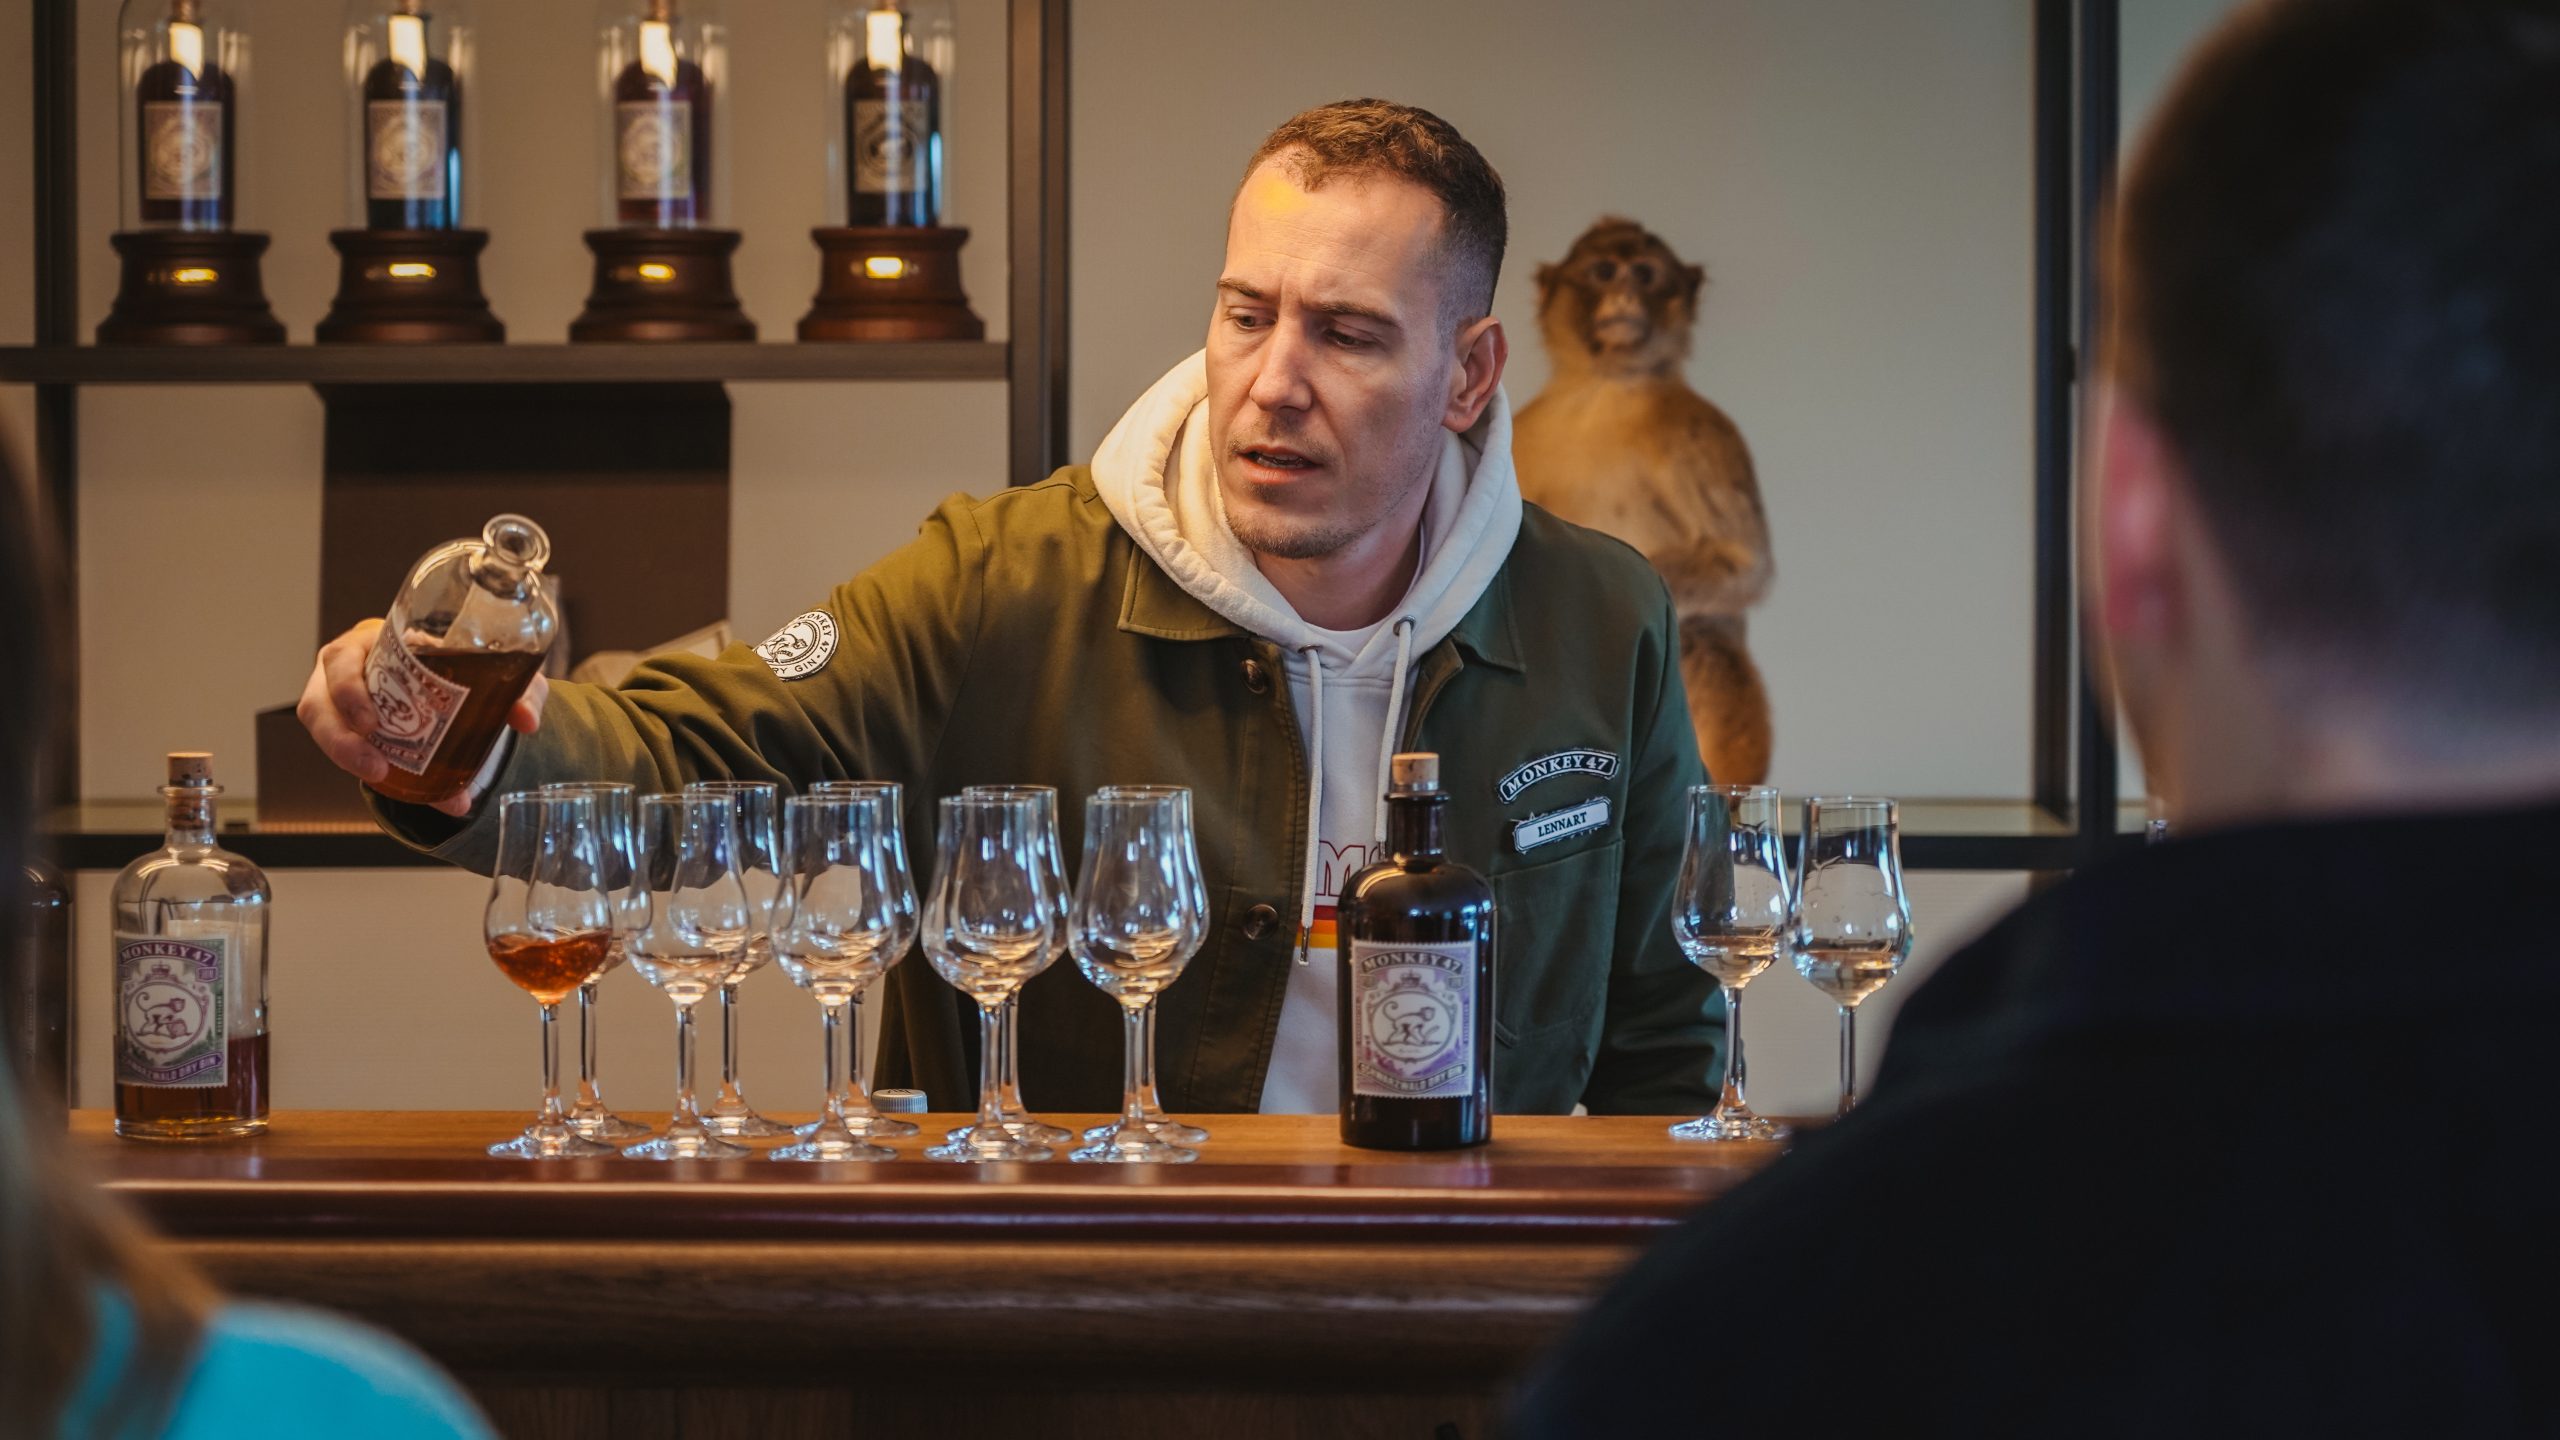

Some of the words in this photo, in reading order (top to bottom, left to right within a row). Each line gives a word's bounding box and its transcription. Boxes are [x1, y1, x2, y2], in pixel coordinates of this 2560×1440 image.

[794, 658, 818, 672] GIN
[1505, 755, 1585, 795] MONKEY
[1586, 757, 1609, 770] 47
[1537, 811, 1587, 838] LENNART
[122, 943, 190, 960] MONKEY
[192, 950, 213, 963] 47
[1363, 952, 1441, 971] MONKEY
[1443, 958, 1462, 971] 47
